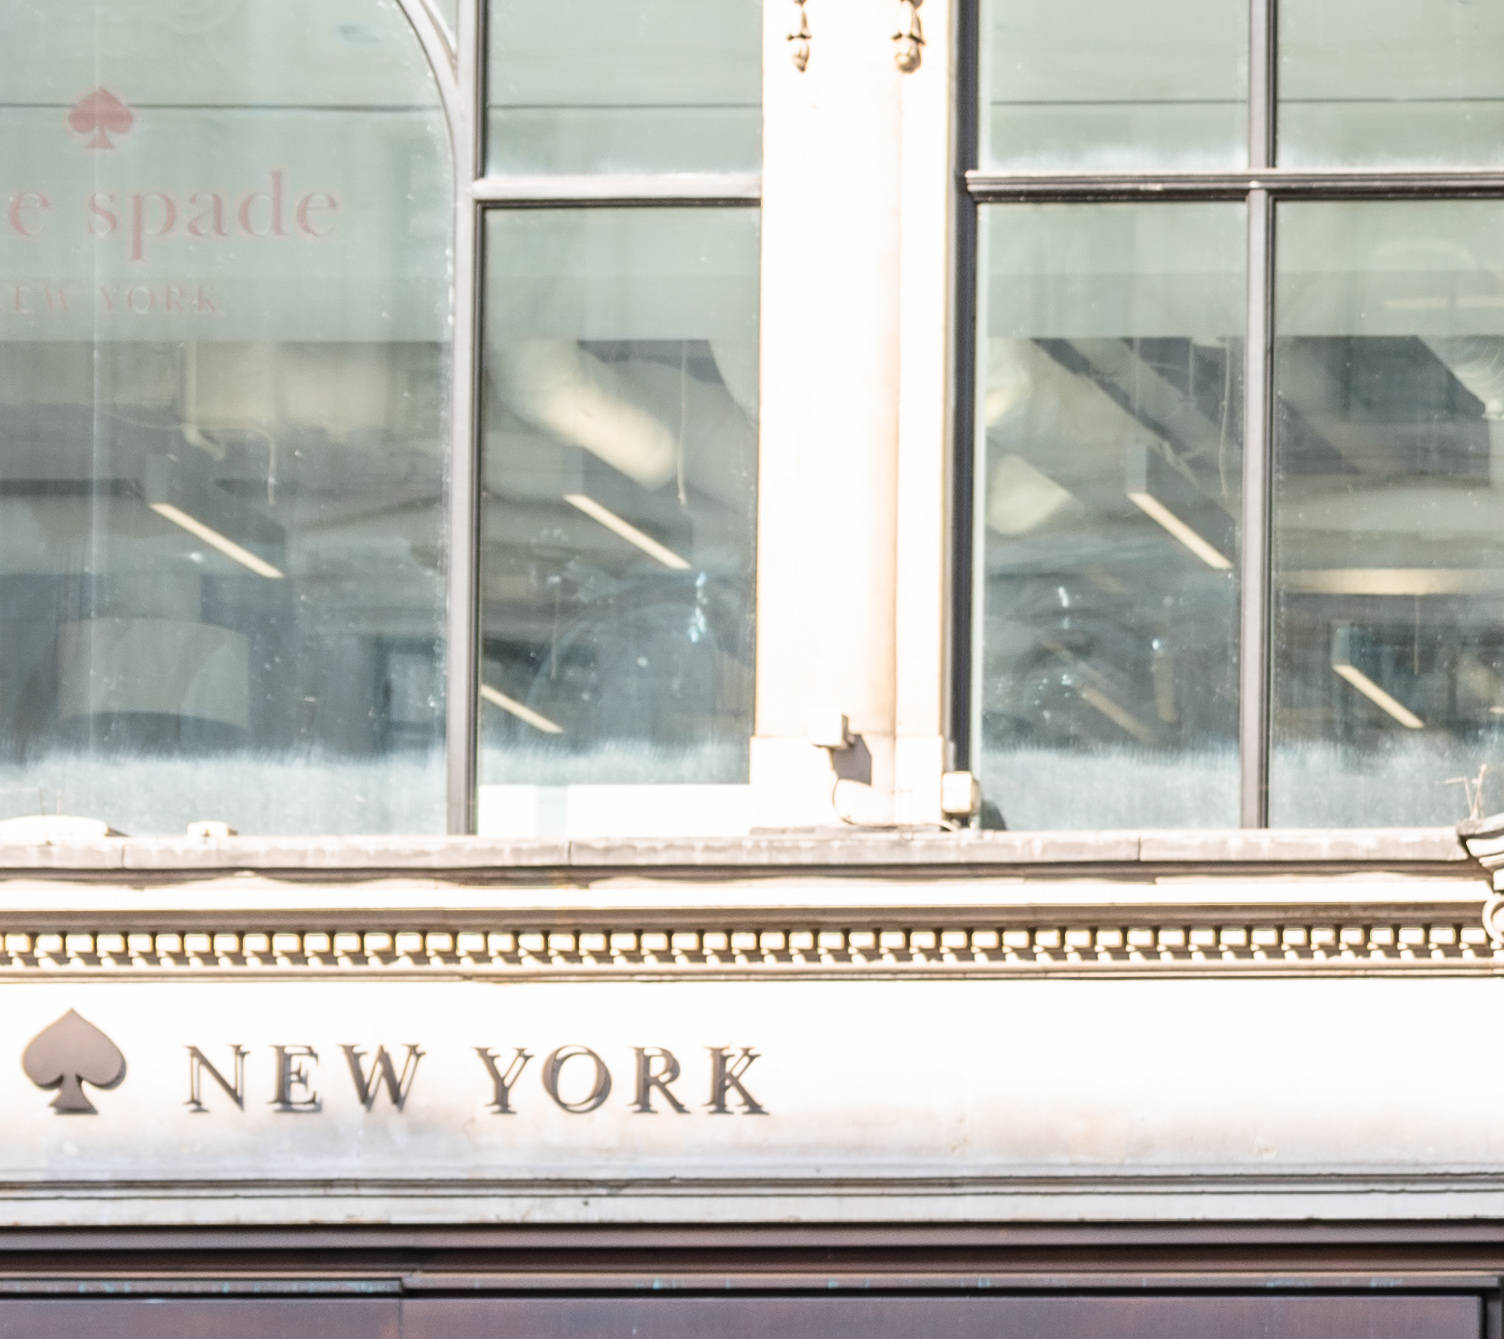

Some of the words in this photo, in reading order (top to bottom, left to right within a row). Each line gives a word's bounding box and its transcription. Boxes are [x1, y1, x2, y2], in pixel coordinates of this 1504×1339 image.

[87, 169, 338, 260] spade
[0, 285, 69, 313] EW
[101, 285, 219, 315] YORK
[184, 1043, 426, 1114] NEW
[474, 1043, 769, 1115] YORK
